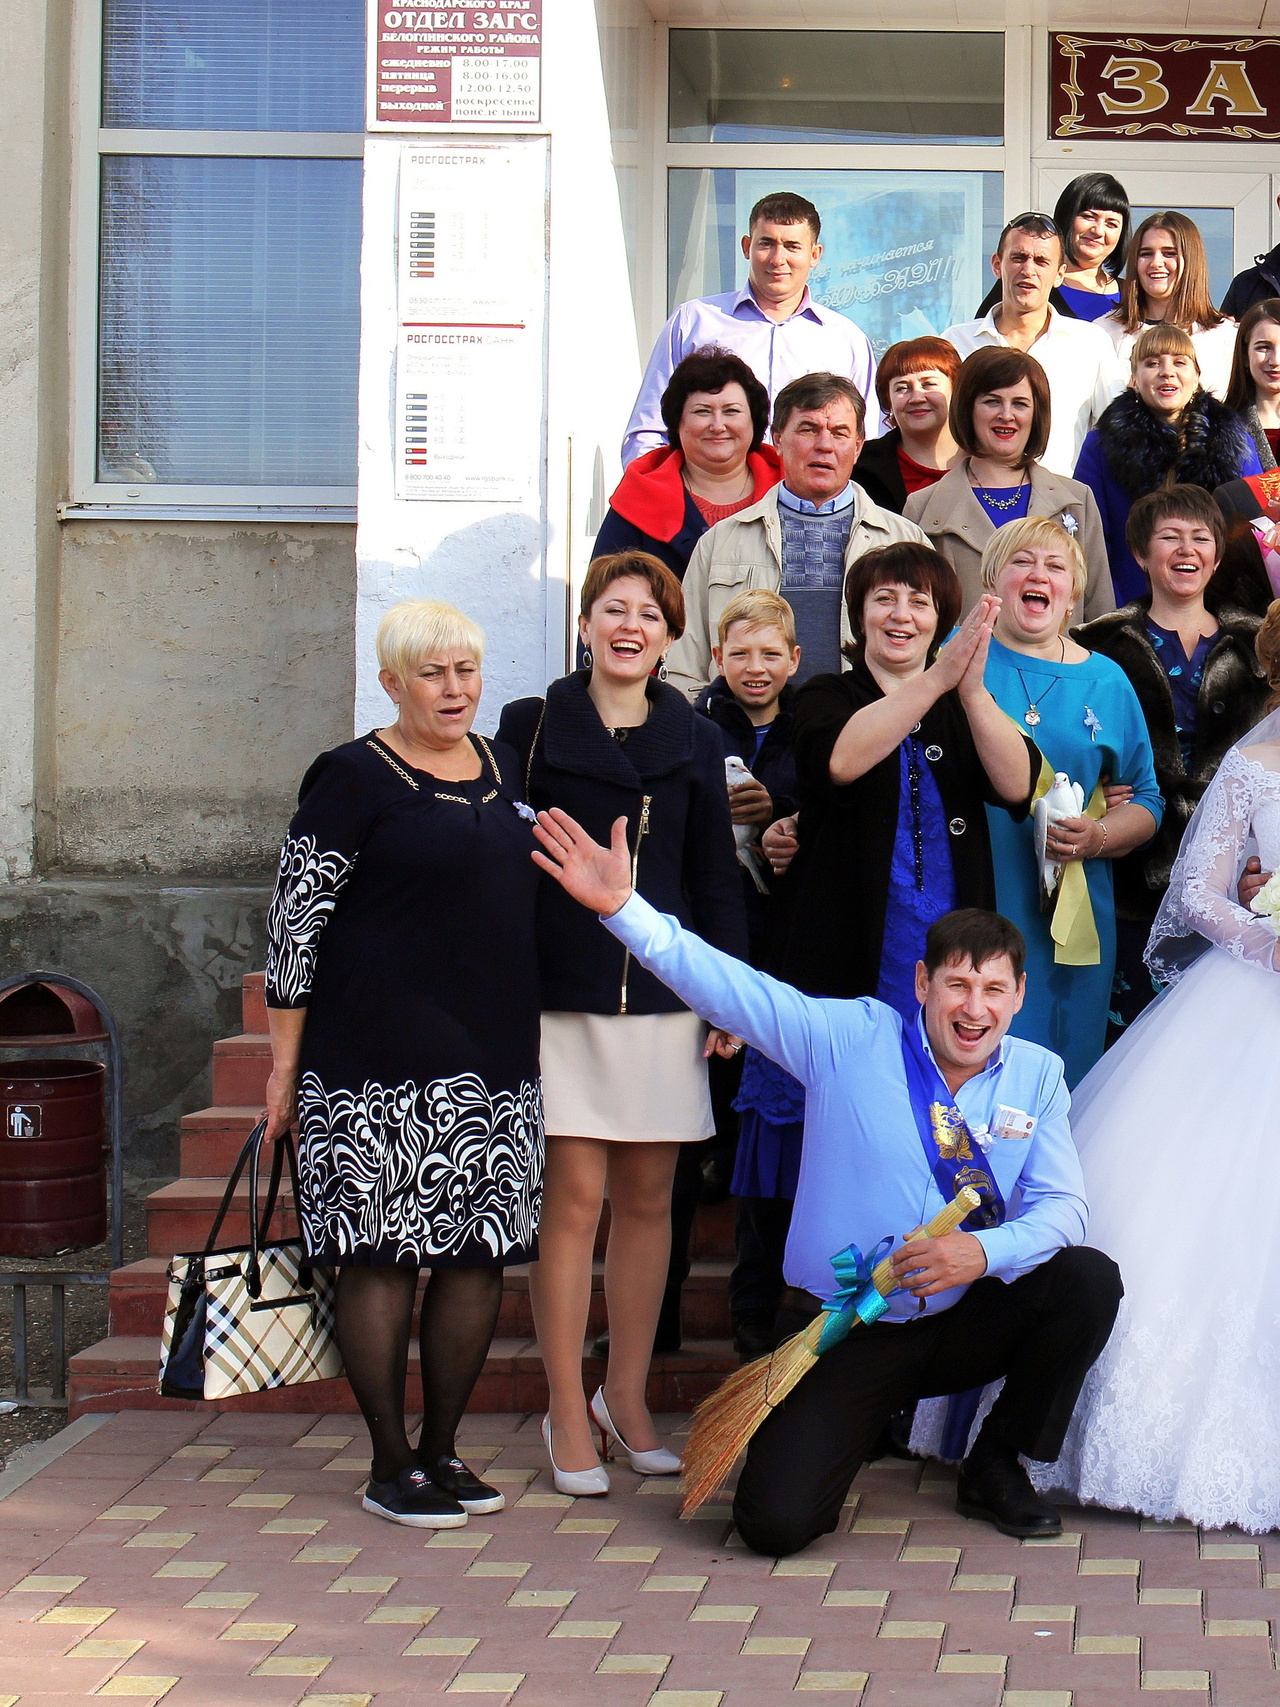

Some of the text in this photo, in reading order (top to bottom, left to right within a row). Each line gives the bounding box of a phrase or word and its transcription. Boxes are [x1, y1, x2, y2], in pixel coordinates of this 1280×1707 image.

[392, 0, 530, 10] КРАСНОДАРСКОГО КРАЯ
[384, 11, 538, 32] ОТДЕЛ ЗАГС
[382, 32, 540, 44] БЕЛОГЛИНСКОГО РАЙОНА
[417, 45, 505, 54] РЕЖИМ РАБОТЫ
[381, 59, 451, 69] ежедневно
[381, 71, 436, 81] пятница
[381, 84, 438, 95] перерыв
[380, 101, 446, 113] выходной
[411, 155, 486, 165] РОСГОССТРАХ
[406, 334, 483, 345] РОСГОССТРАХ
